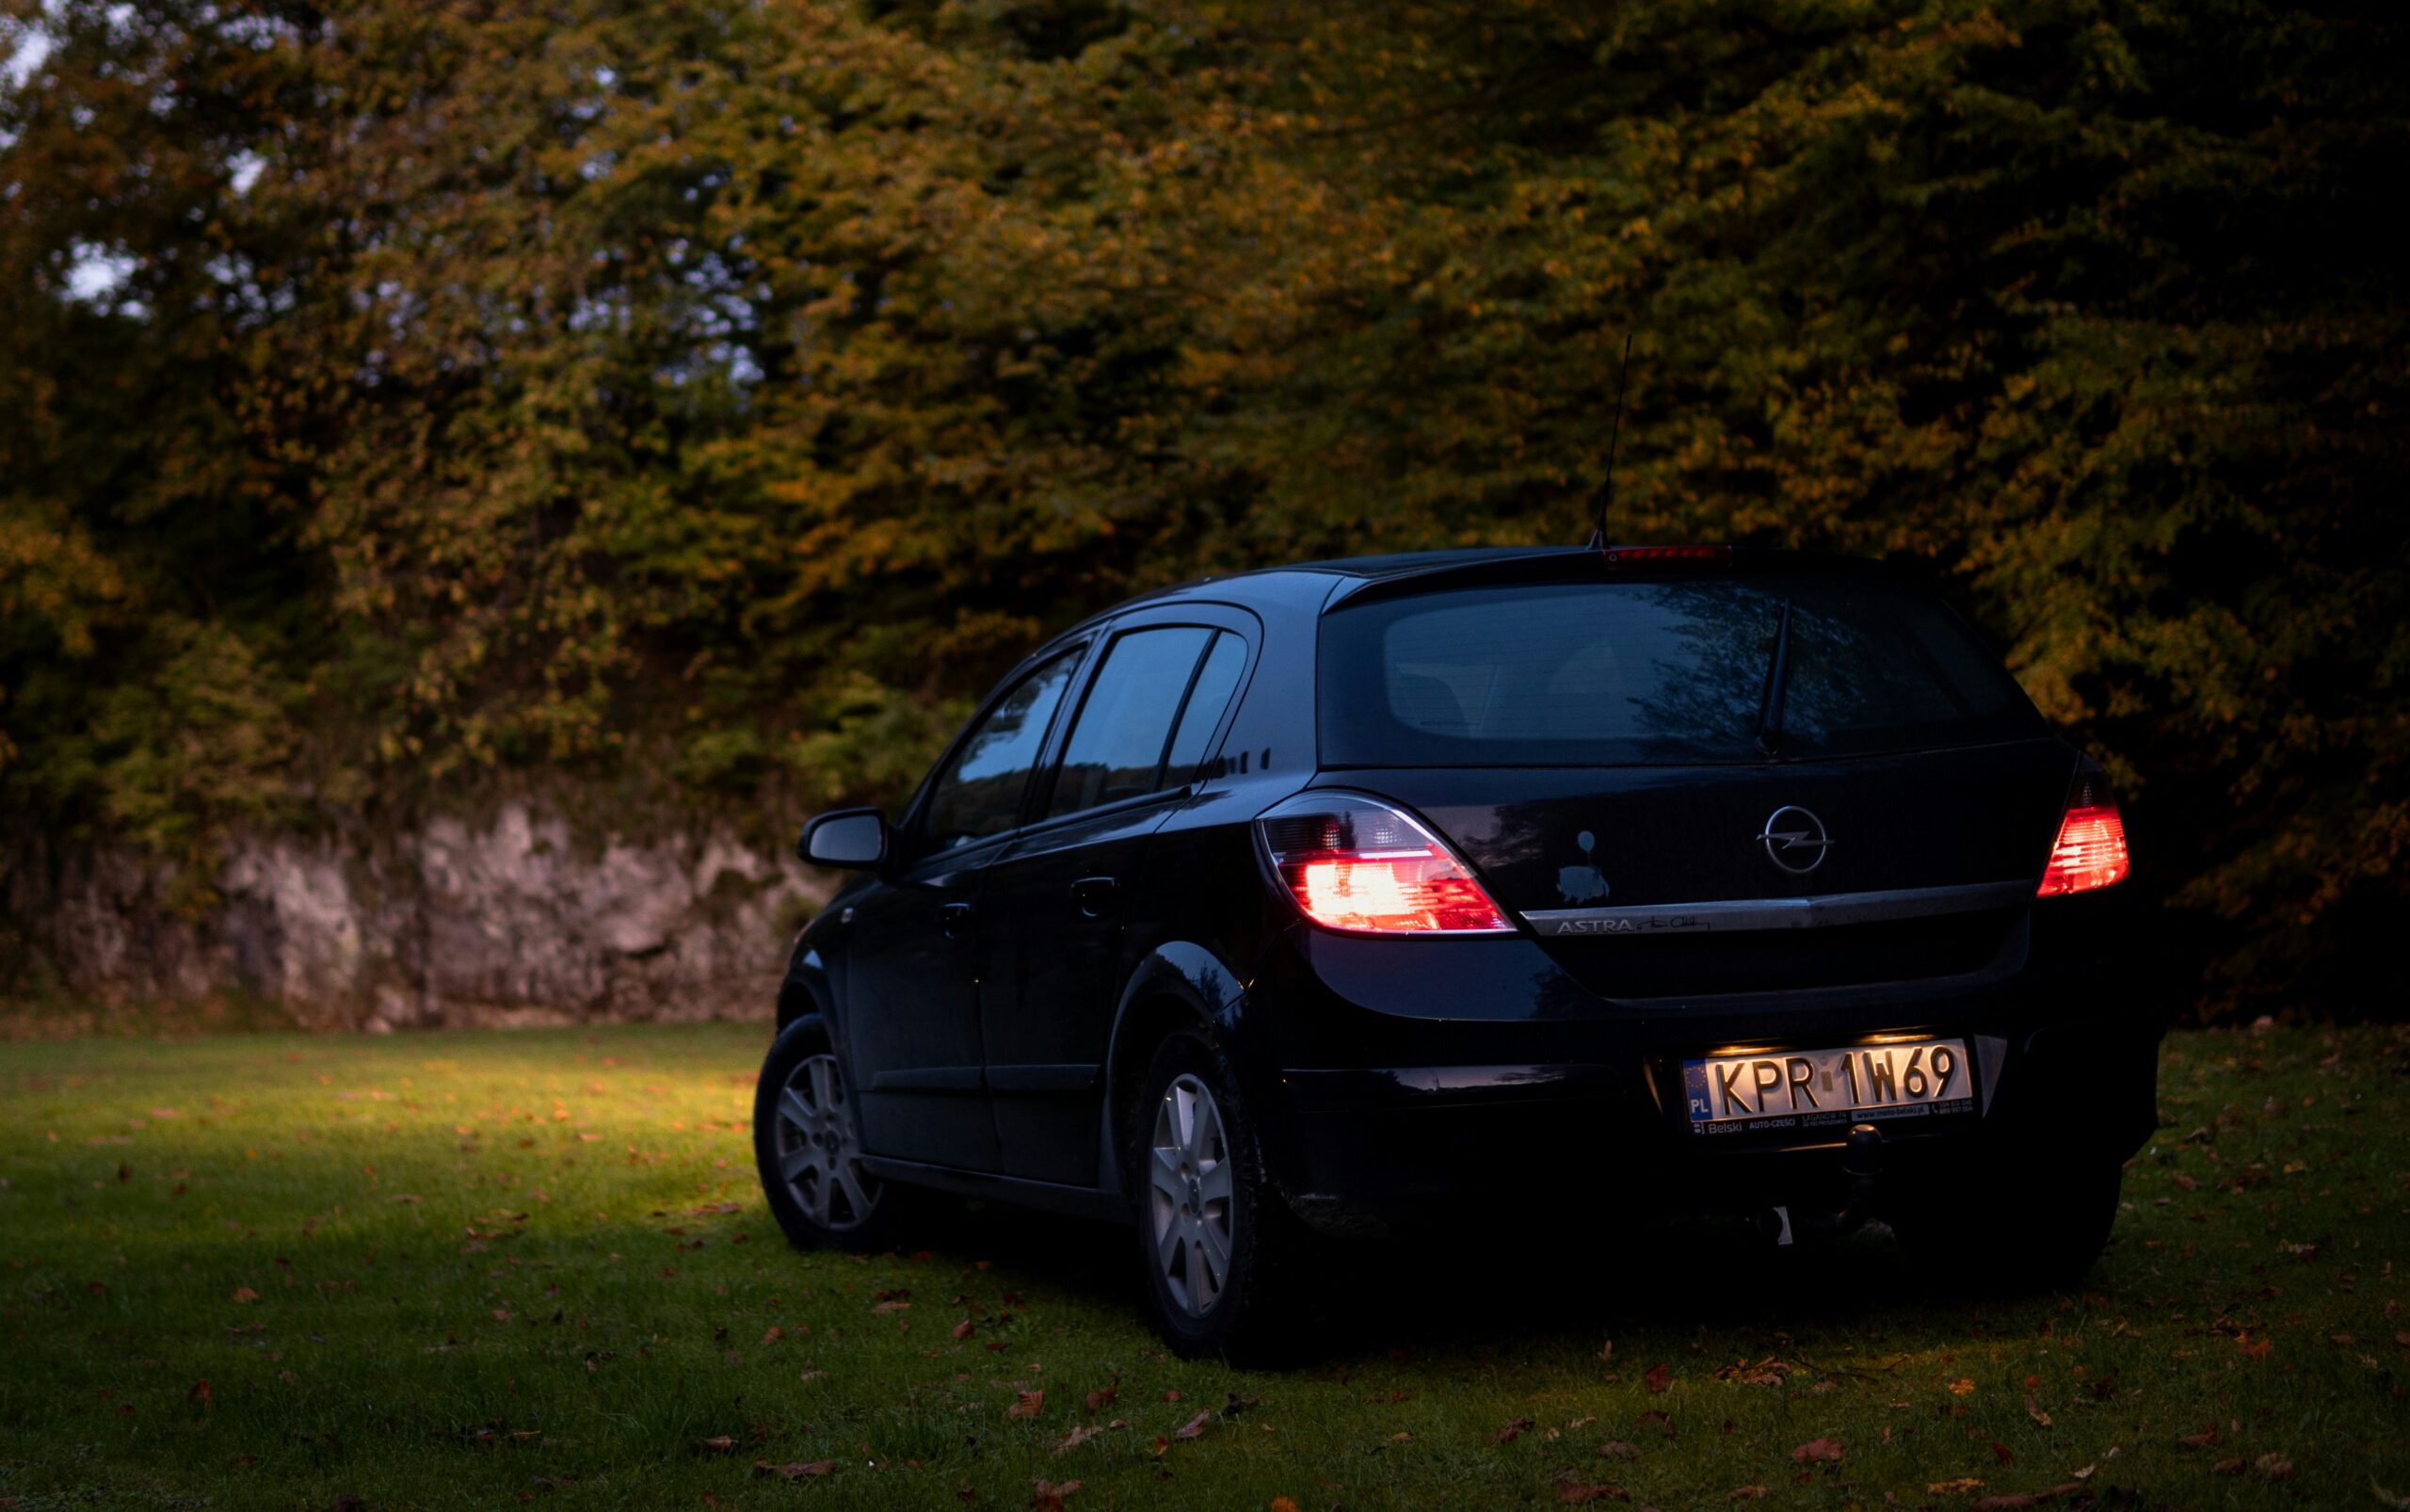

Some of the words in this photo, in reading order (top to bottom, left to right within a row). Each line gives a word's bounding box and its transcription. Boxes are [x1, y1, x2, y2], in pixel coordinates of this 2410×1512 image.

[1557, 919, 1634, 934] ASTRA
[1715, 1057, 1819, 1115] KPR
[1840, 1046, 1955, 1104] 1W69
[1691, 1099, 1709, 1114] PL
[1708, 1122, 1743, 1134] Belski
